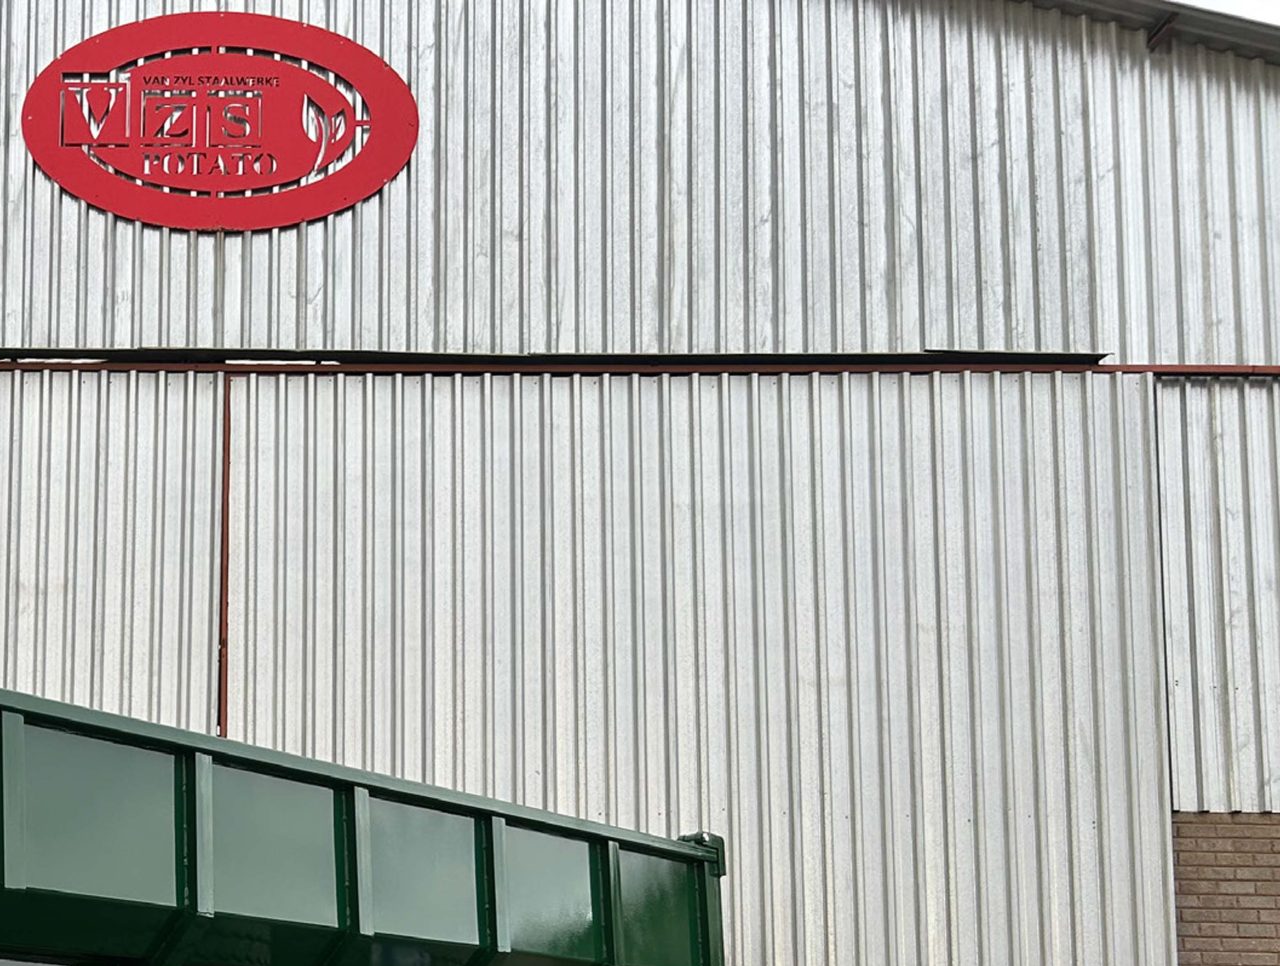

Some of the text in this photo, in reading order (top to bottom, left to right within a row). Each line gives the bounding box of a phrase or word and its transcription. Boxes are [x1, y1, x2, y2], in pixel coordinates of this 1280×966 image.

[143, 76, 280, 87] VAN ZYL STAALWERKE
[142, 152, 277, 176] POTATO
